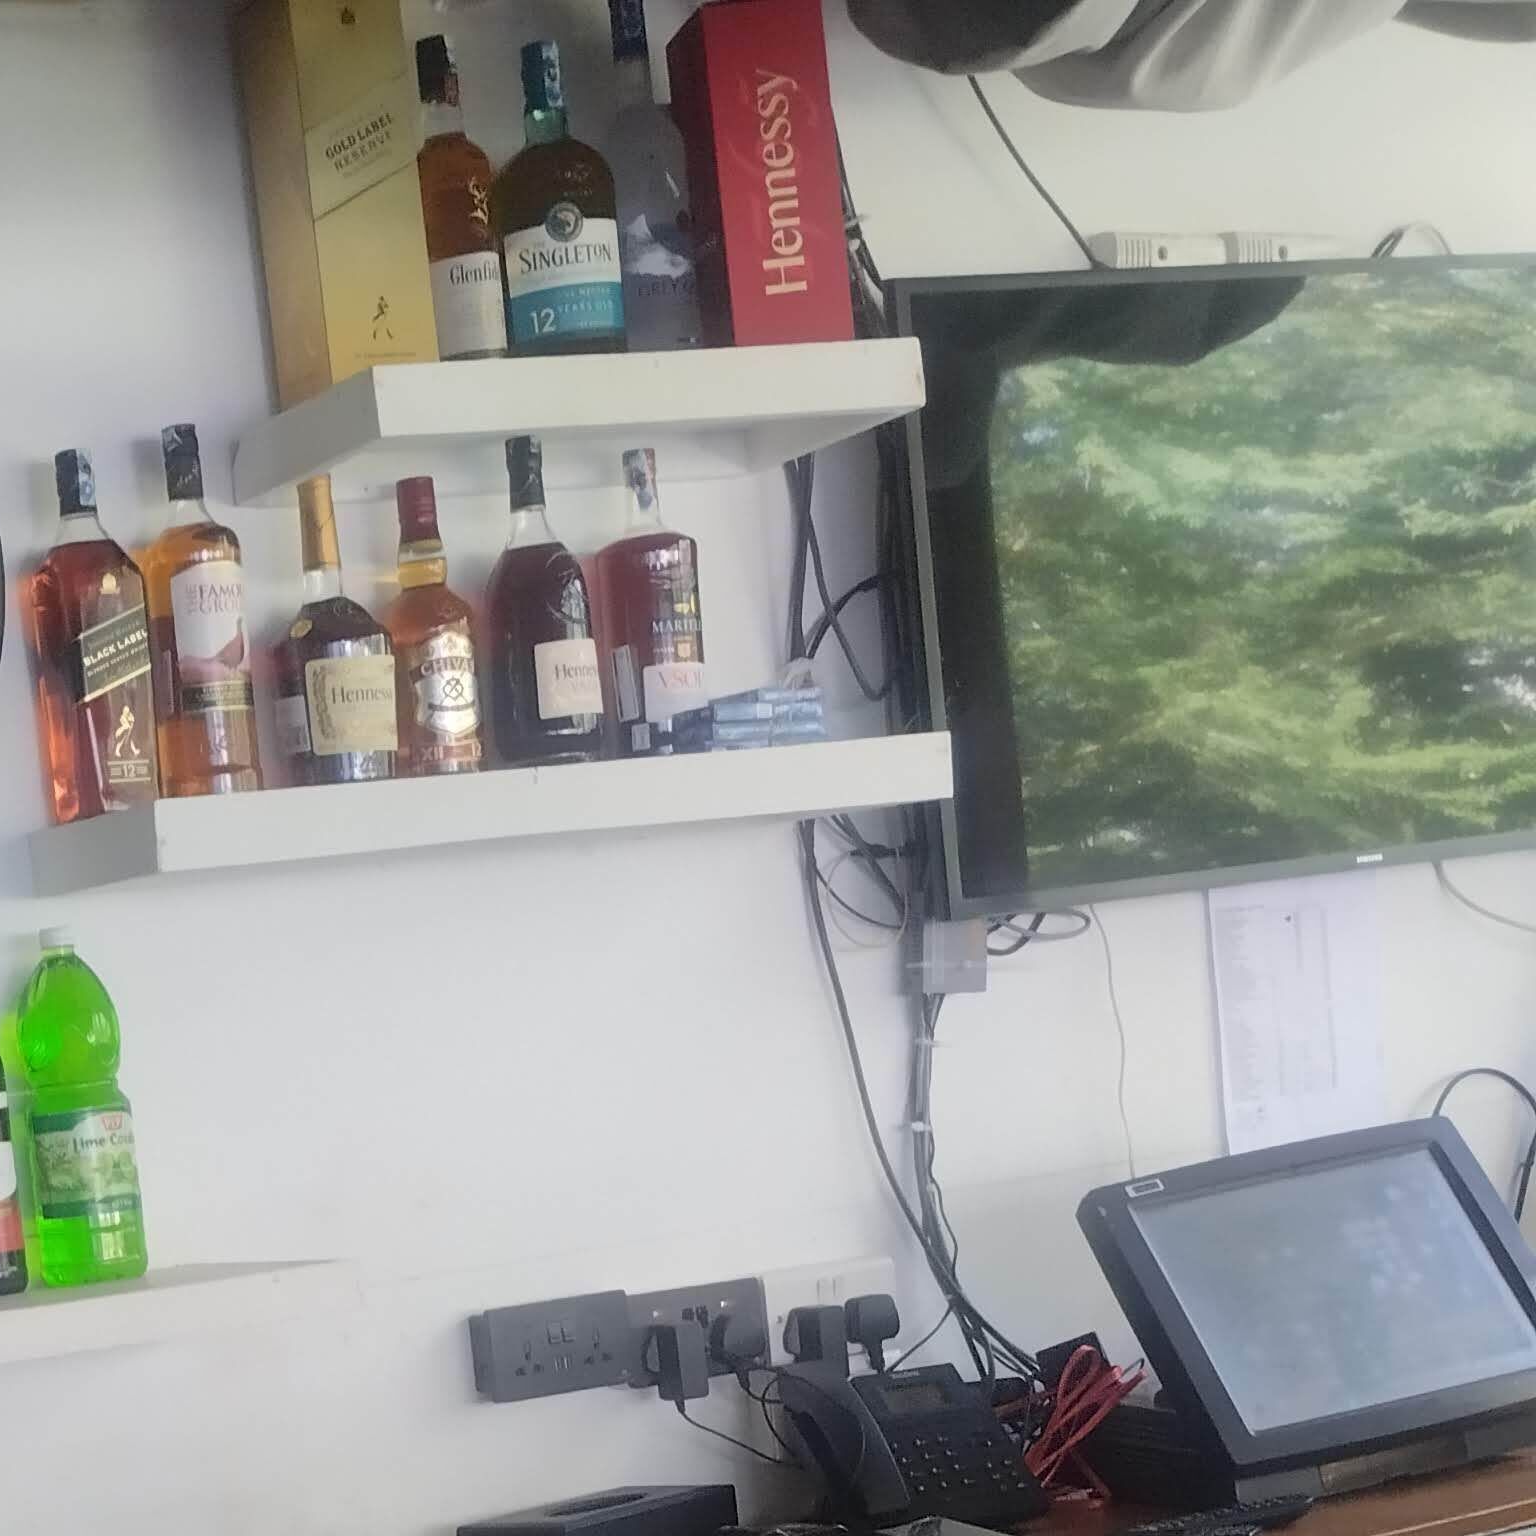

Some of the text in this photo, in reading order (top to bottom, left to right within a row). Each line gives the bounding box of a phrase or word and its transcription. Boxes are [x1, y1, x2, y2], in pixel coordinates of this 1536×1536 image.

[325, 134, 356, 159] GOLD
[755, 68, 808, 296] Hennessy
[519, 243, 612, 274] SINGLETON
[529, 307, 557, 334] 12
[82, 643, 117, 667] BLACK
[116, 628, 148, 650] LABEL
[123, 764, 137, 778] 12
